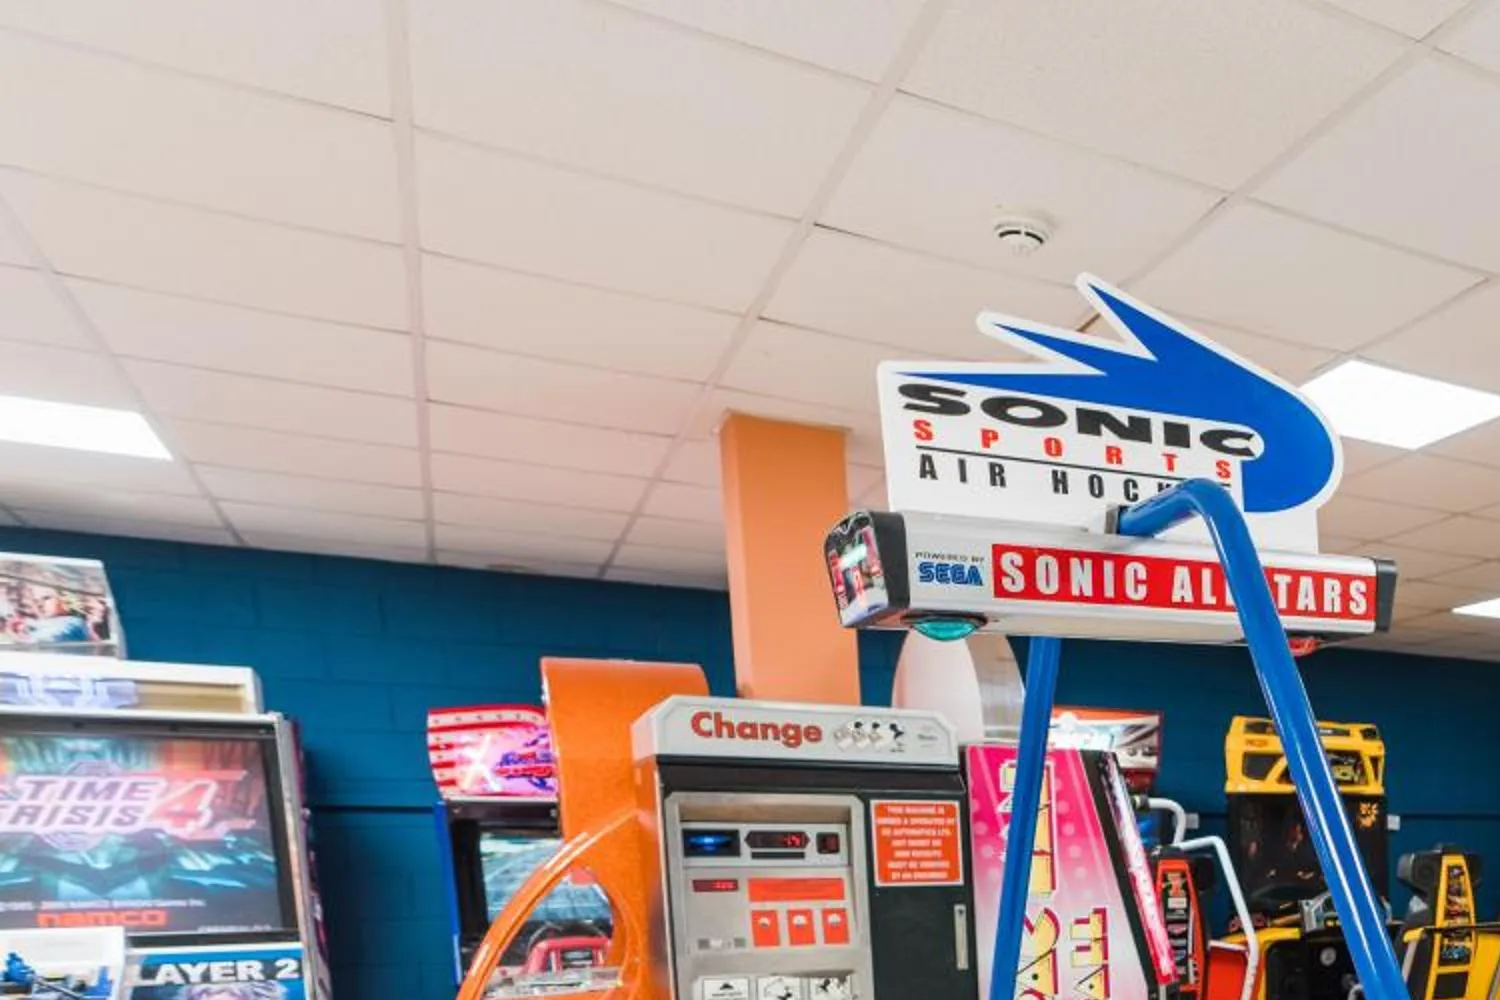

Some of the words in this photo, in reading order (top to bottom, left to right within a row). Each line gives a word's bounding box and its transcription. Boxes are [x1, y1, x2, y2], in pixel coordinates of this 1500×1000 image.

[897, 382, 1257, 458] SONIC
[912, 418, 1232, 480] SPORTS
[919, 452, 1007, 488] AIR
[918, 561, 984, 587] SEGA
[1001, 551, 1148, 601] SONIC
[1171, 565, 1368, 616] ALTARS
[691, 711, 823, 748] Change
[0, 803, 146, 827] RISIS
[24, 779, 159, 801] TIME
[152, 778, 219, 832] 4
[36, 909, 168, 927] namco
[128, 959, 264, 986] LAYER
[275, 957, 300, 980] 2
